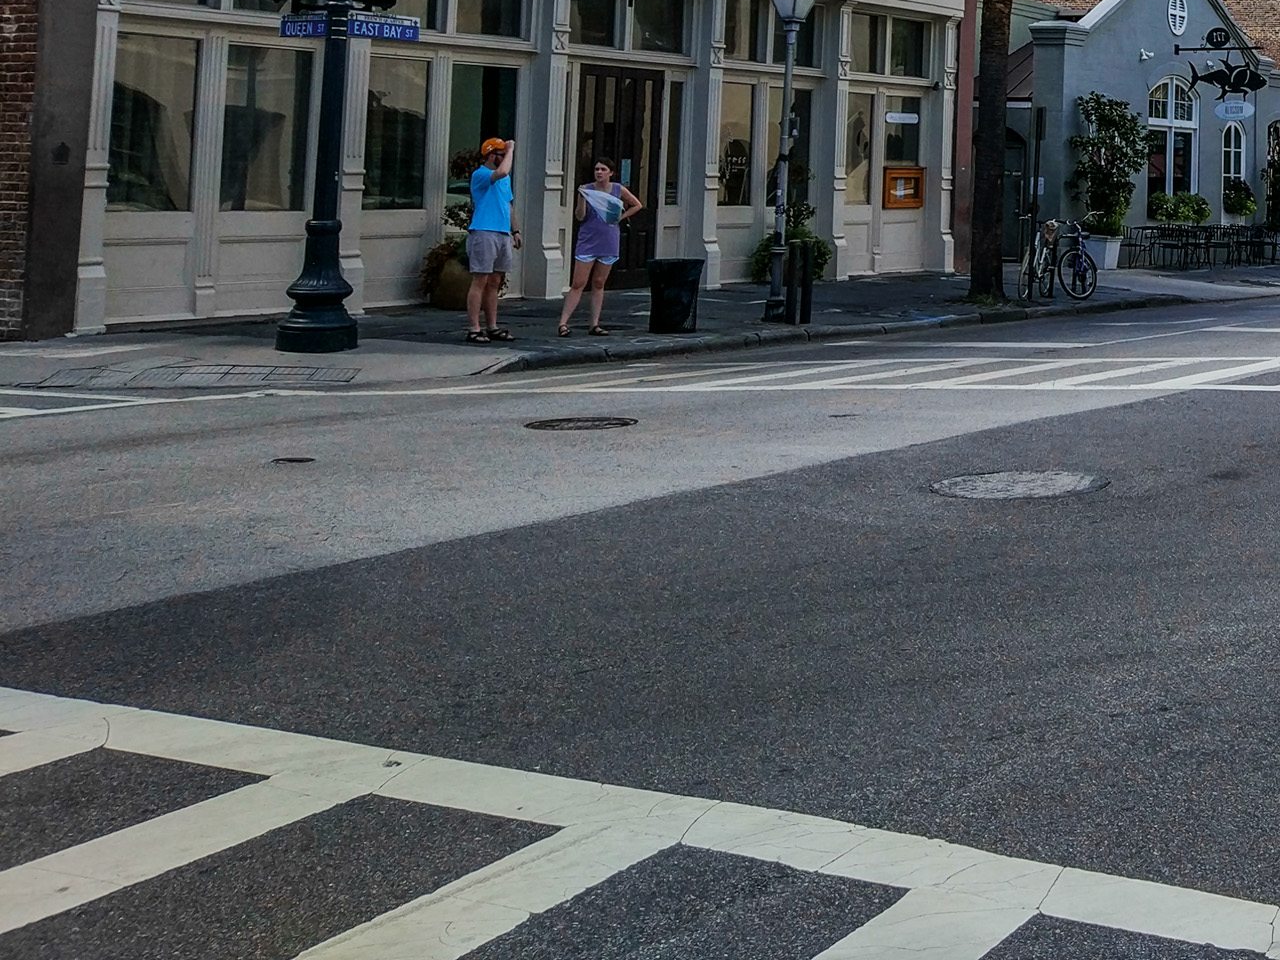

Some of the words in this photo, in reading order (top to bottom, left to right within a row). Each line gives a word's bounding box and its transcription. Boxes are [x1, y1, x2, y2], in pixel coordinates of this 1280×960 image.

[285, 21, 313, 36] QUEEN
[317, 23, 325, 33] ST
[354, 21, 380, 36] EAST
[383, 25, 402, 39] BAY
[405, 29, 414, 38] ST
